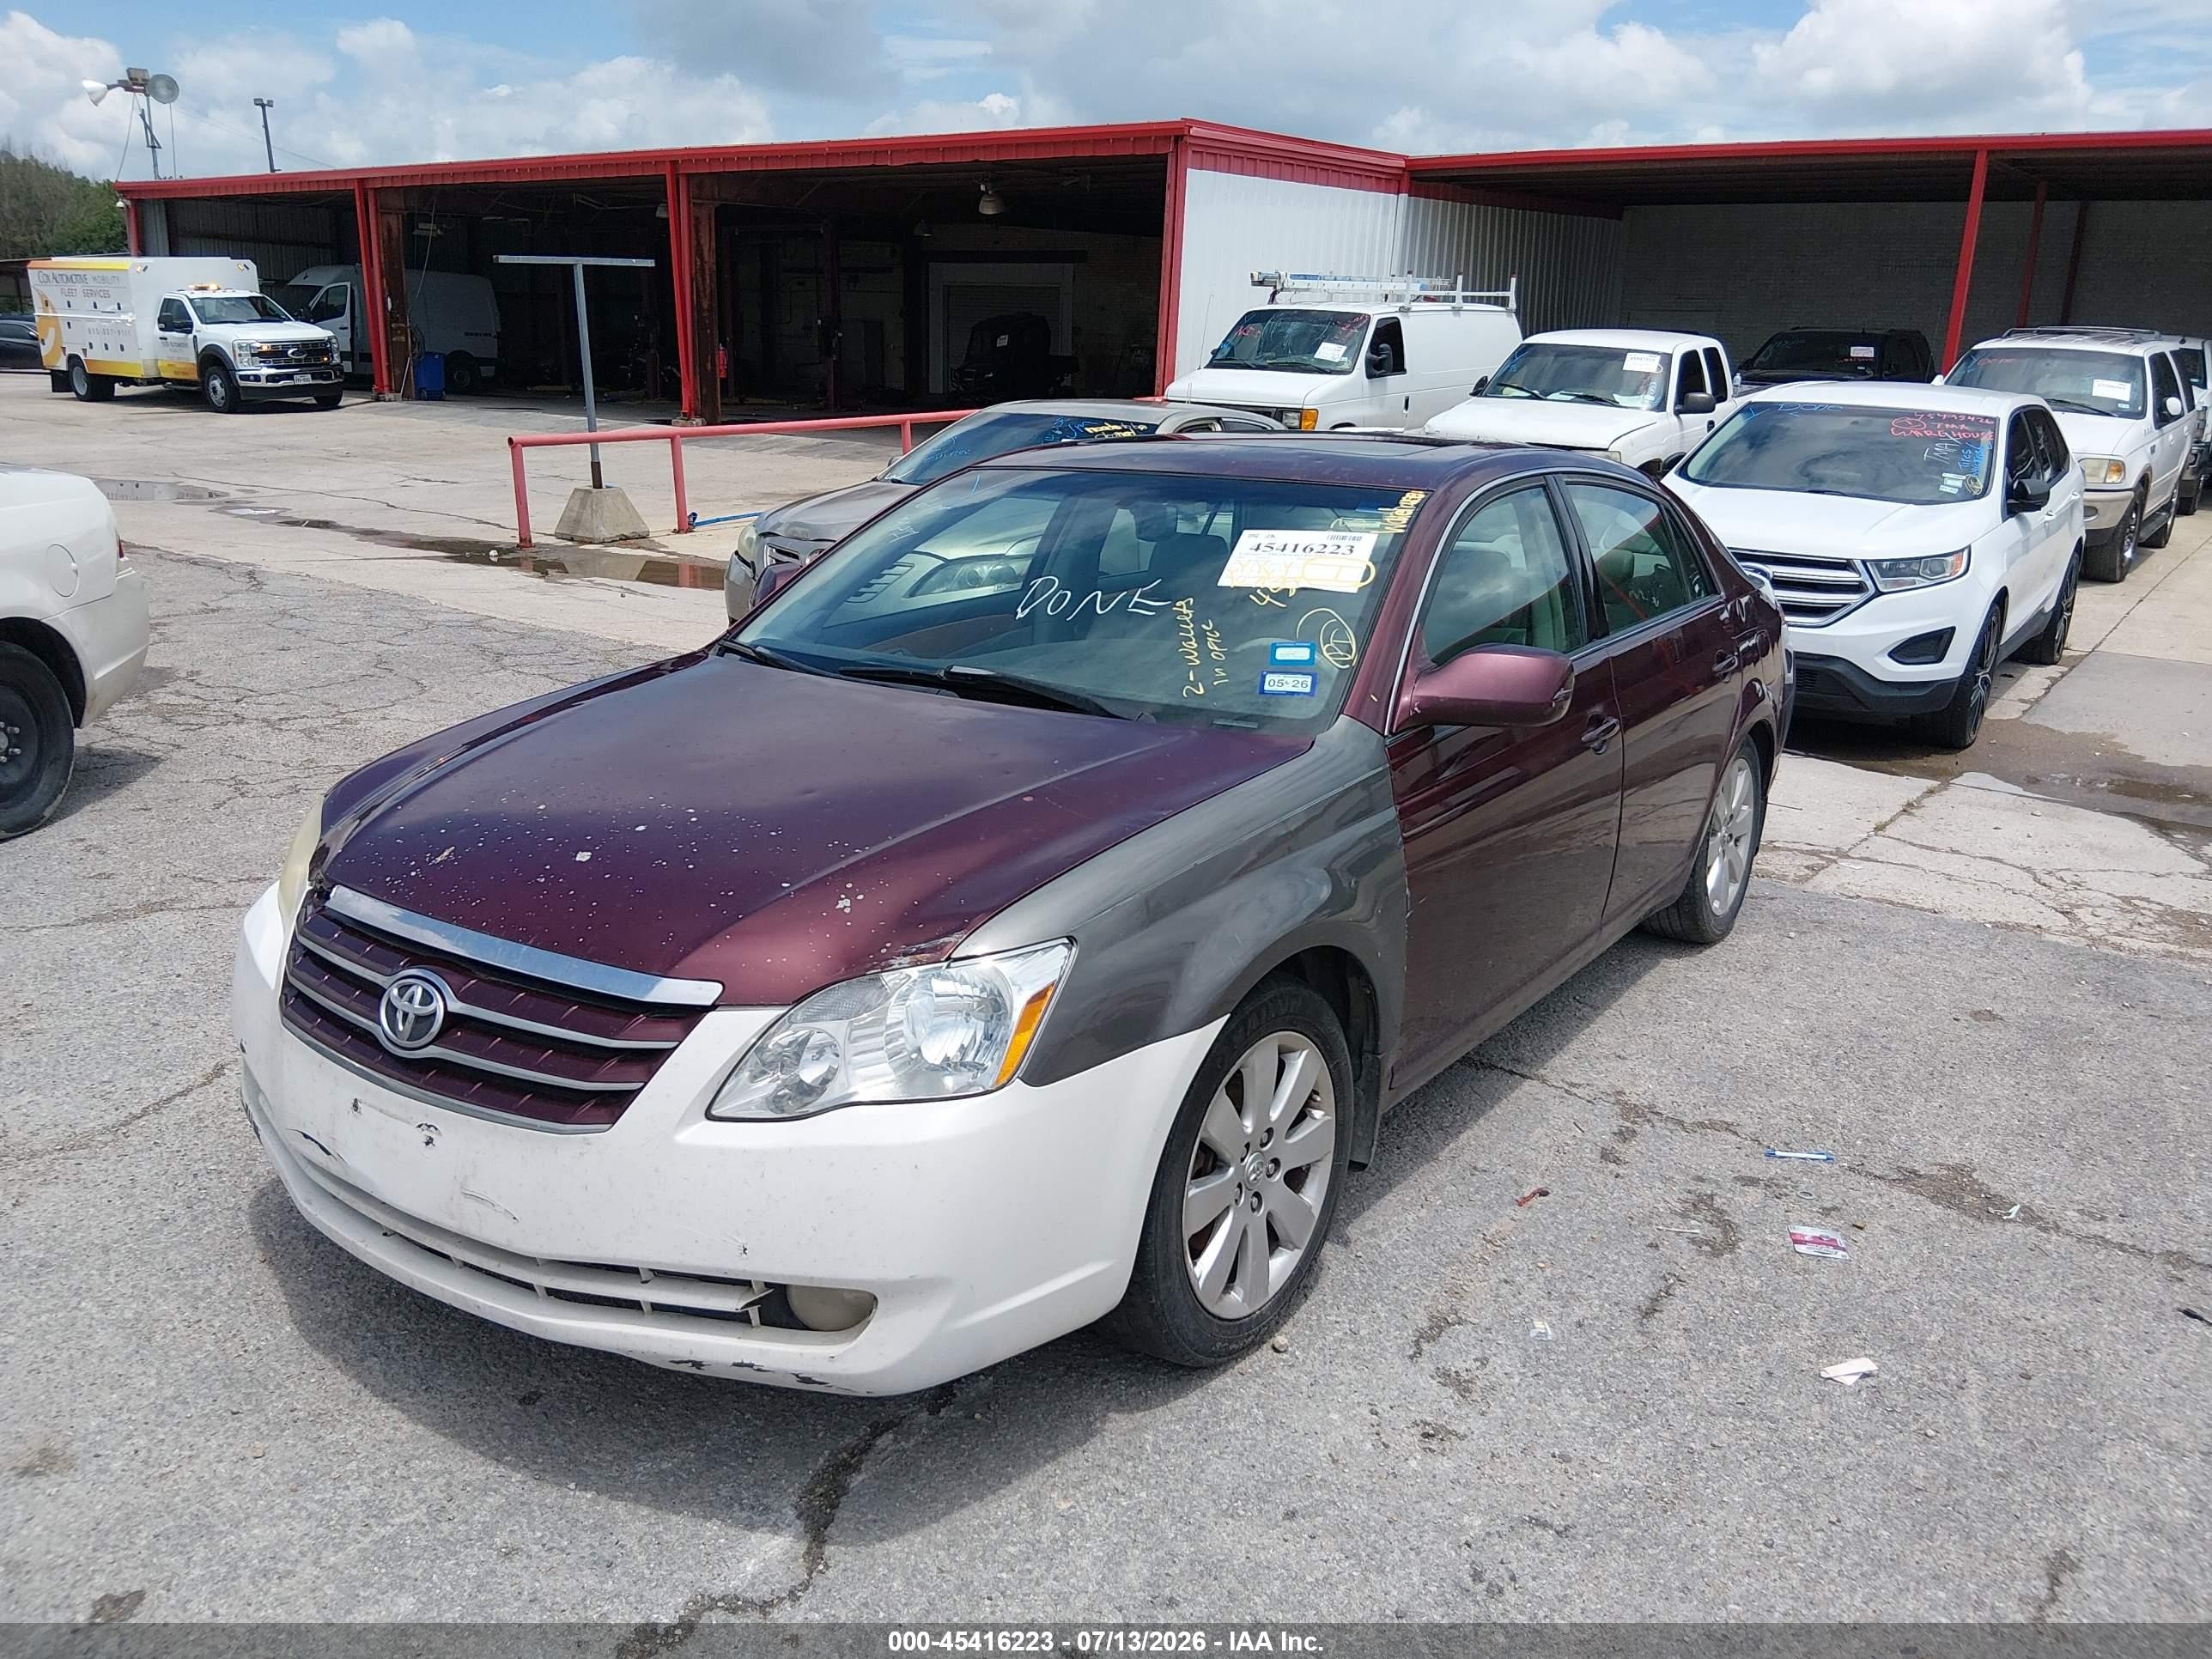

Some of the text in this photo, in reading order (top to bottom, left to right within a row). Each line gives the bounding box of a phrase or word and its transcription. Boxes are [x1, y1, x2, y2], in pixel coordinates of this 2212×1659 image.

[92, 275, 120, 284] MOBILITY
[61, 289, 111, 298] FLEET SERVICES
[1249, 542, 1356, 556] 45416223
[1016, 575, 1172, 621] DONE
[1268, 679, 1309, 689] 05 26
